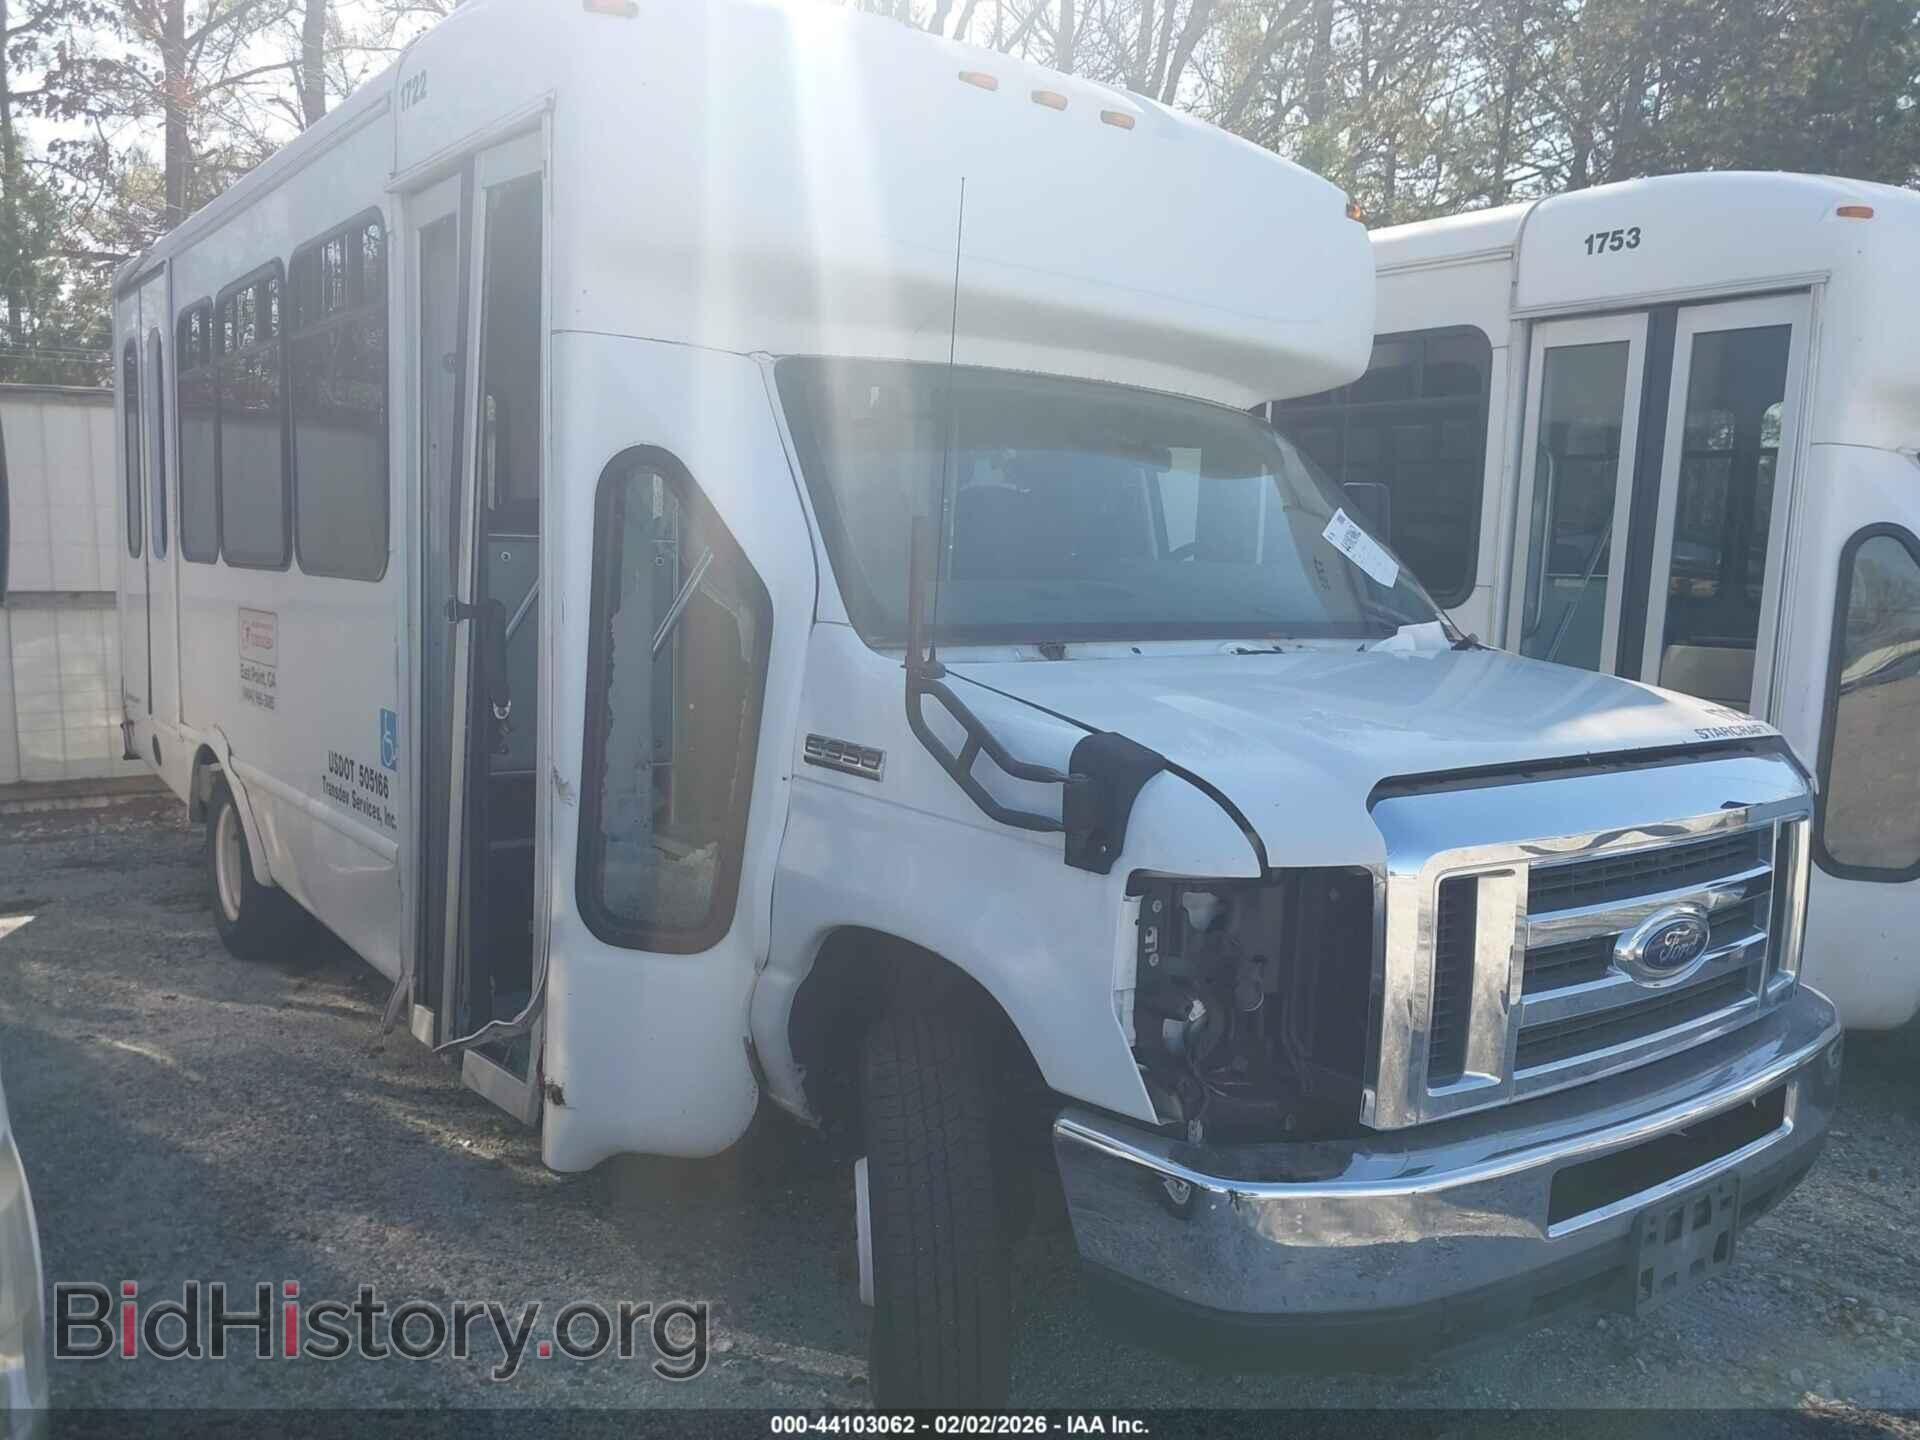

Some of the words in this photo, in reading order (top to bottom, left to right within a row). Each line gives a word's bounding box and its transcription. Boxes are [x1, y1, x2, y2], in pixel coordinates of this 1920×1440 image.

[400, 70, 427, 112] 1722
[1584, 227, 1641, 255] 1753
[1694, 725, 1771, 740] STARCRAFT
[328, 750, 354, 783] USDOT
[359, 764, 389, 799] 505166
[351, 789, 383, 827] Services,
[384, 806, 398, 830] Inc.
[1659, 926, 1699, 961] Ford
